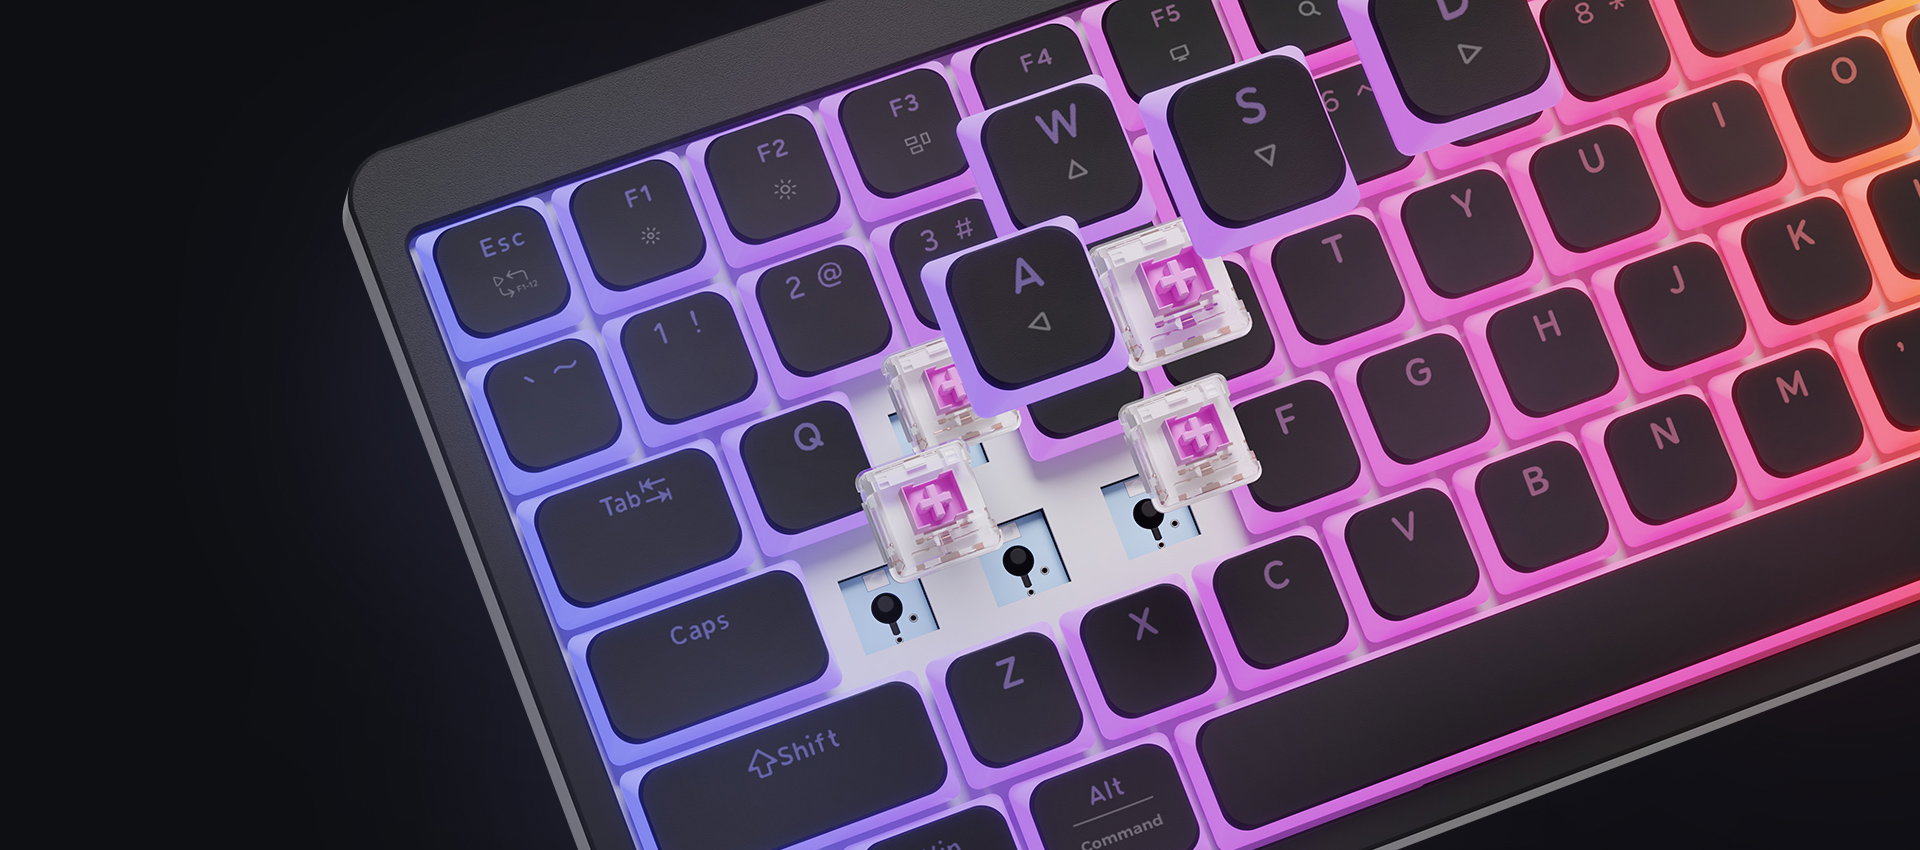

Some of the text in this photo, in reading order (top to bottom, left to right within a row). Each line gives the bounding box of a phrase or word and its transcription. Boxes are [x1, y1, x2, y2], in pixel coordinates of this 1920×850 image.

[1150, 3, 1181, 28] F5
[1574, 1, 1595, 25] 8
[1019, 47, 1053, 73] F4
[1830, 56, 1858, 85] O
[888, 93, 920, 118] F3
[1235, 86, 1267, 125] S
[1321, 90, 1340, 112] 6
[1711, 101, 1726, 128] I
[1034, 102, 1077, 145] W
[756, 138, 789, 163] F2
[1577, 143, 1605, 174] U
[623, 184, 652, 209] F1
[1450, 188, 1473, 218] Y
[479, 232, 526, 258] Esc
[919, 216, 974, 252] 3 #
[1321, 233, 1344, 264] T
[1786, 218, 1816, 251] K
[785, 261, 843, 300] 2 @
[1014, 256, 1045, 295] A
[1669, 264, 1686, 295] J
[653, 310, 701, 345] 1 !
[1532, 309, 1562, 343] H
[1405, 357, 1432, 386] G
[1775, 369, 1809, 404] M
[1274, 402, 1296, 435] F
[1649, 416, 1681, 450] N
[793, 422, 825, 452] Q
[1522, 465, 1550, 497] B
[599, 490, 641, 517] Tab
[1391, 510, 1415, 542] V
[1263, 559, 1290, 590] C
[670, 614, 730, 645] Caps
[1127, 607, 1159, 641] X
[995, 655, 1025, 690] Z
[777, 729, 840, 766] Shift
[1090, 777, 1125, 806] Alt
[1080, 813, 1164, 850] Command
